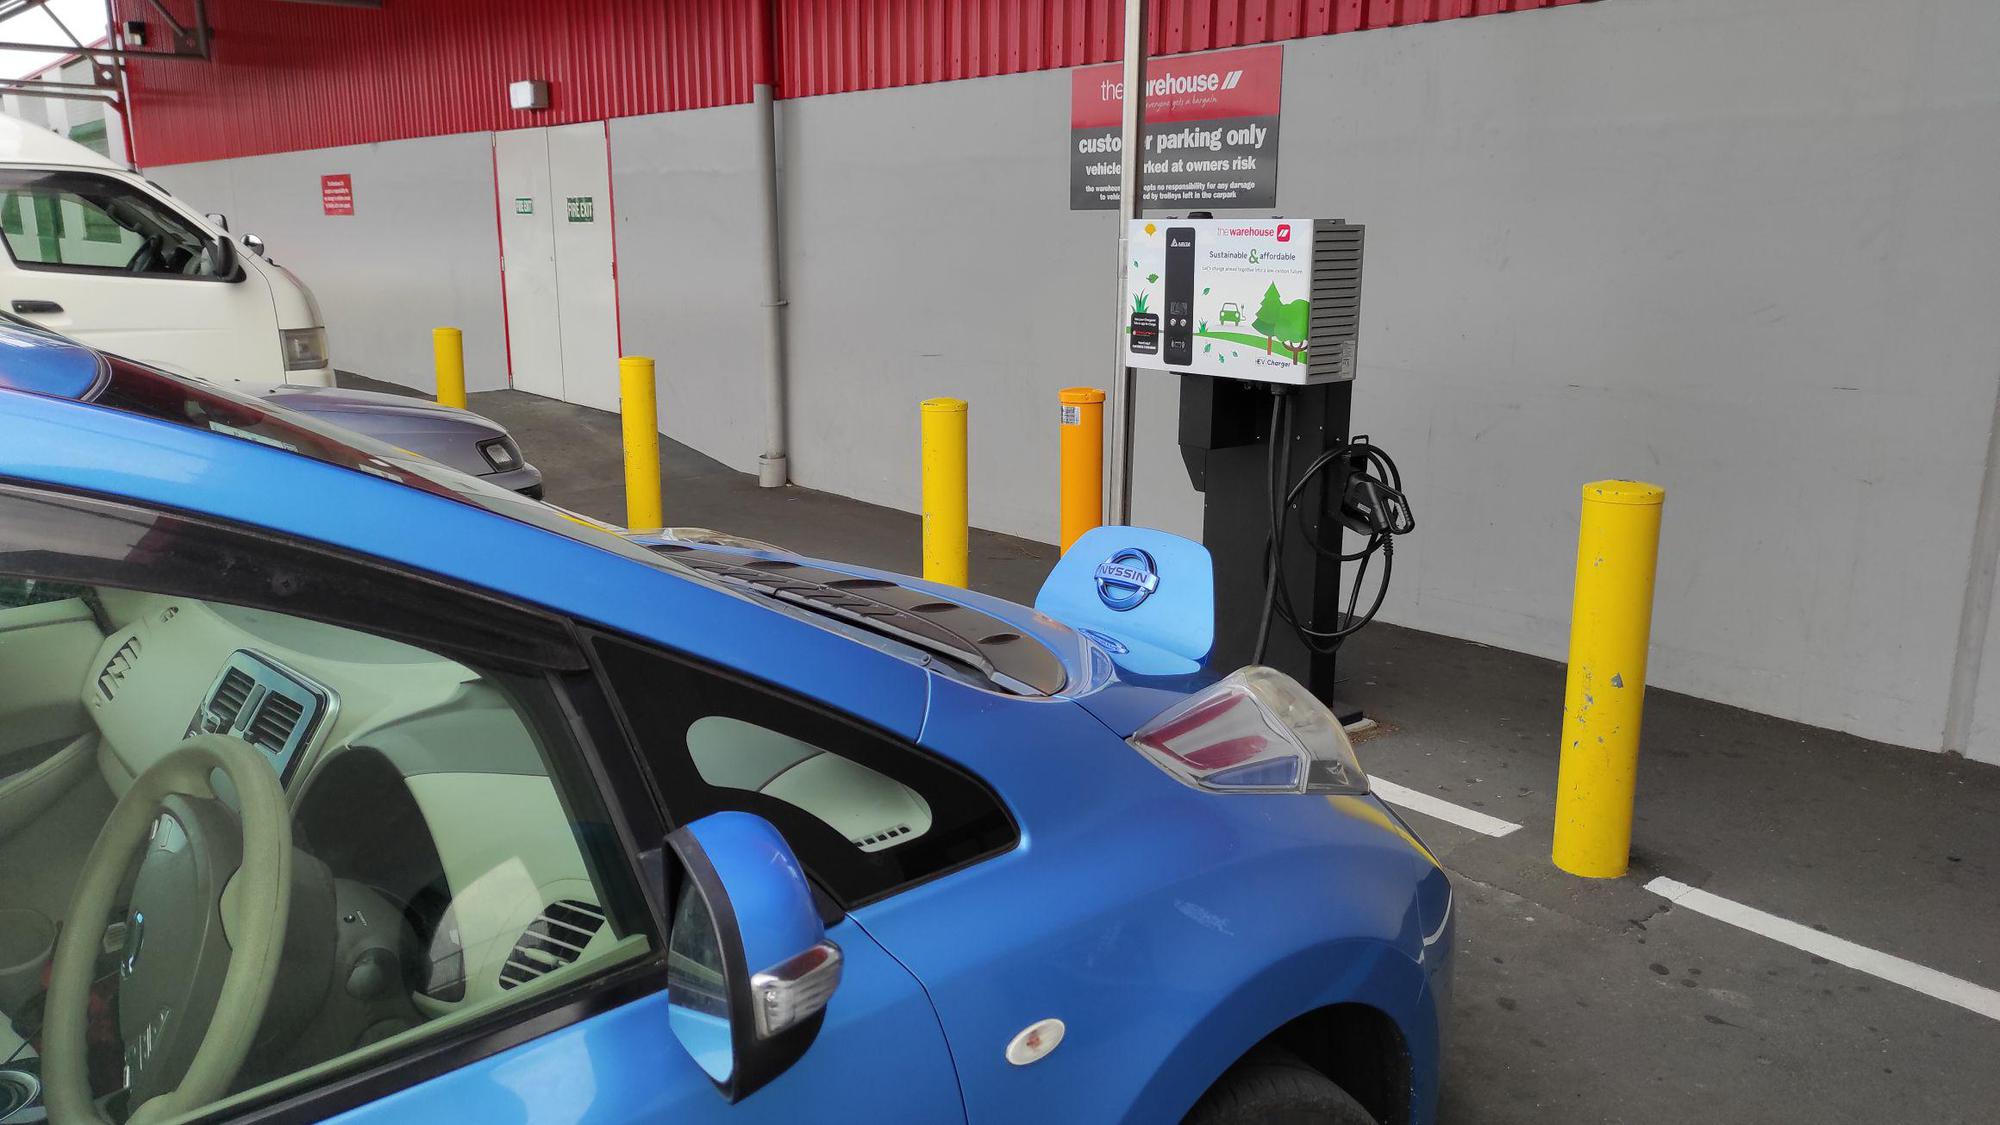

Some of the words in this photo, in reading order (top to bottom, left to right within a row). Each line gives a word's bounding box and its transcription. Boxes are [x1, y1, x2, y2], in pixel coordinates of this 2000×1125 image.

[1101, 79, 1123, 100] the
[1146, 72, 1218, 97] rehouse
[1079, 133, 1153, 153] custor
[1157, 127, 1222, 153] parking
[1226, 123, 1267, 149] only
[1085, 161, 1121, 175] vehicle
[1144, 160, 1168, 174] rked
[1171, 159, 1183, 172] at
[1186, 159, 1229, 172] owners
[1232, 155, 1256, 170] risk
[1166, 182, 1205, 191] responsibility
[1229, 181, 1255, 190] damage
[1151, 192, 1158, 200] by
[1159, 192, 1181, 200] trolleys
[1201, 191, 1212, 199] the
[1213, 191, 1237, 199] carpark
[567, 202, 580, 218] FIRE
[580, 202, 592, 218] EXIT
[1217, 227, 1229, 236] the
[1229, 227, 1274, 236] warehouse
[1209, 250, 1247, 259] Sustainable
[1248, 248, 1260, 264] &
[1260, 252, 1296, 260] affordable
[1267, 359, 1290, 368] Charger
[1100, 565, 1147, 583] NISSAN
